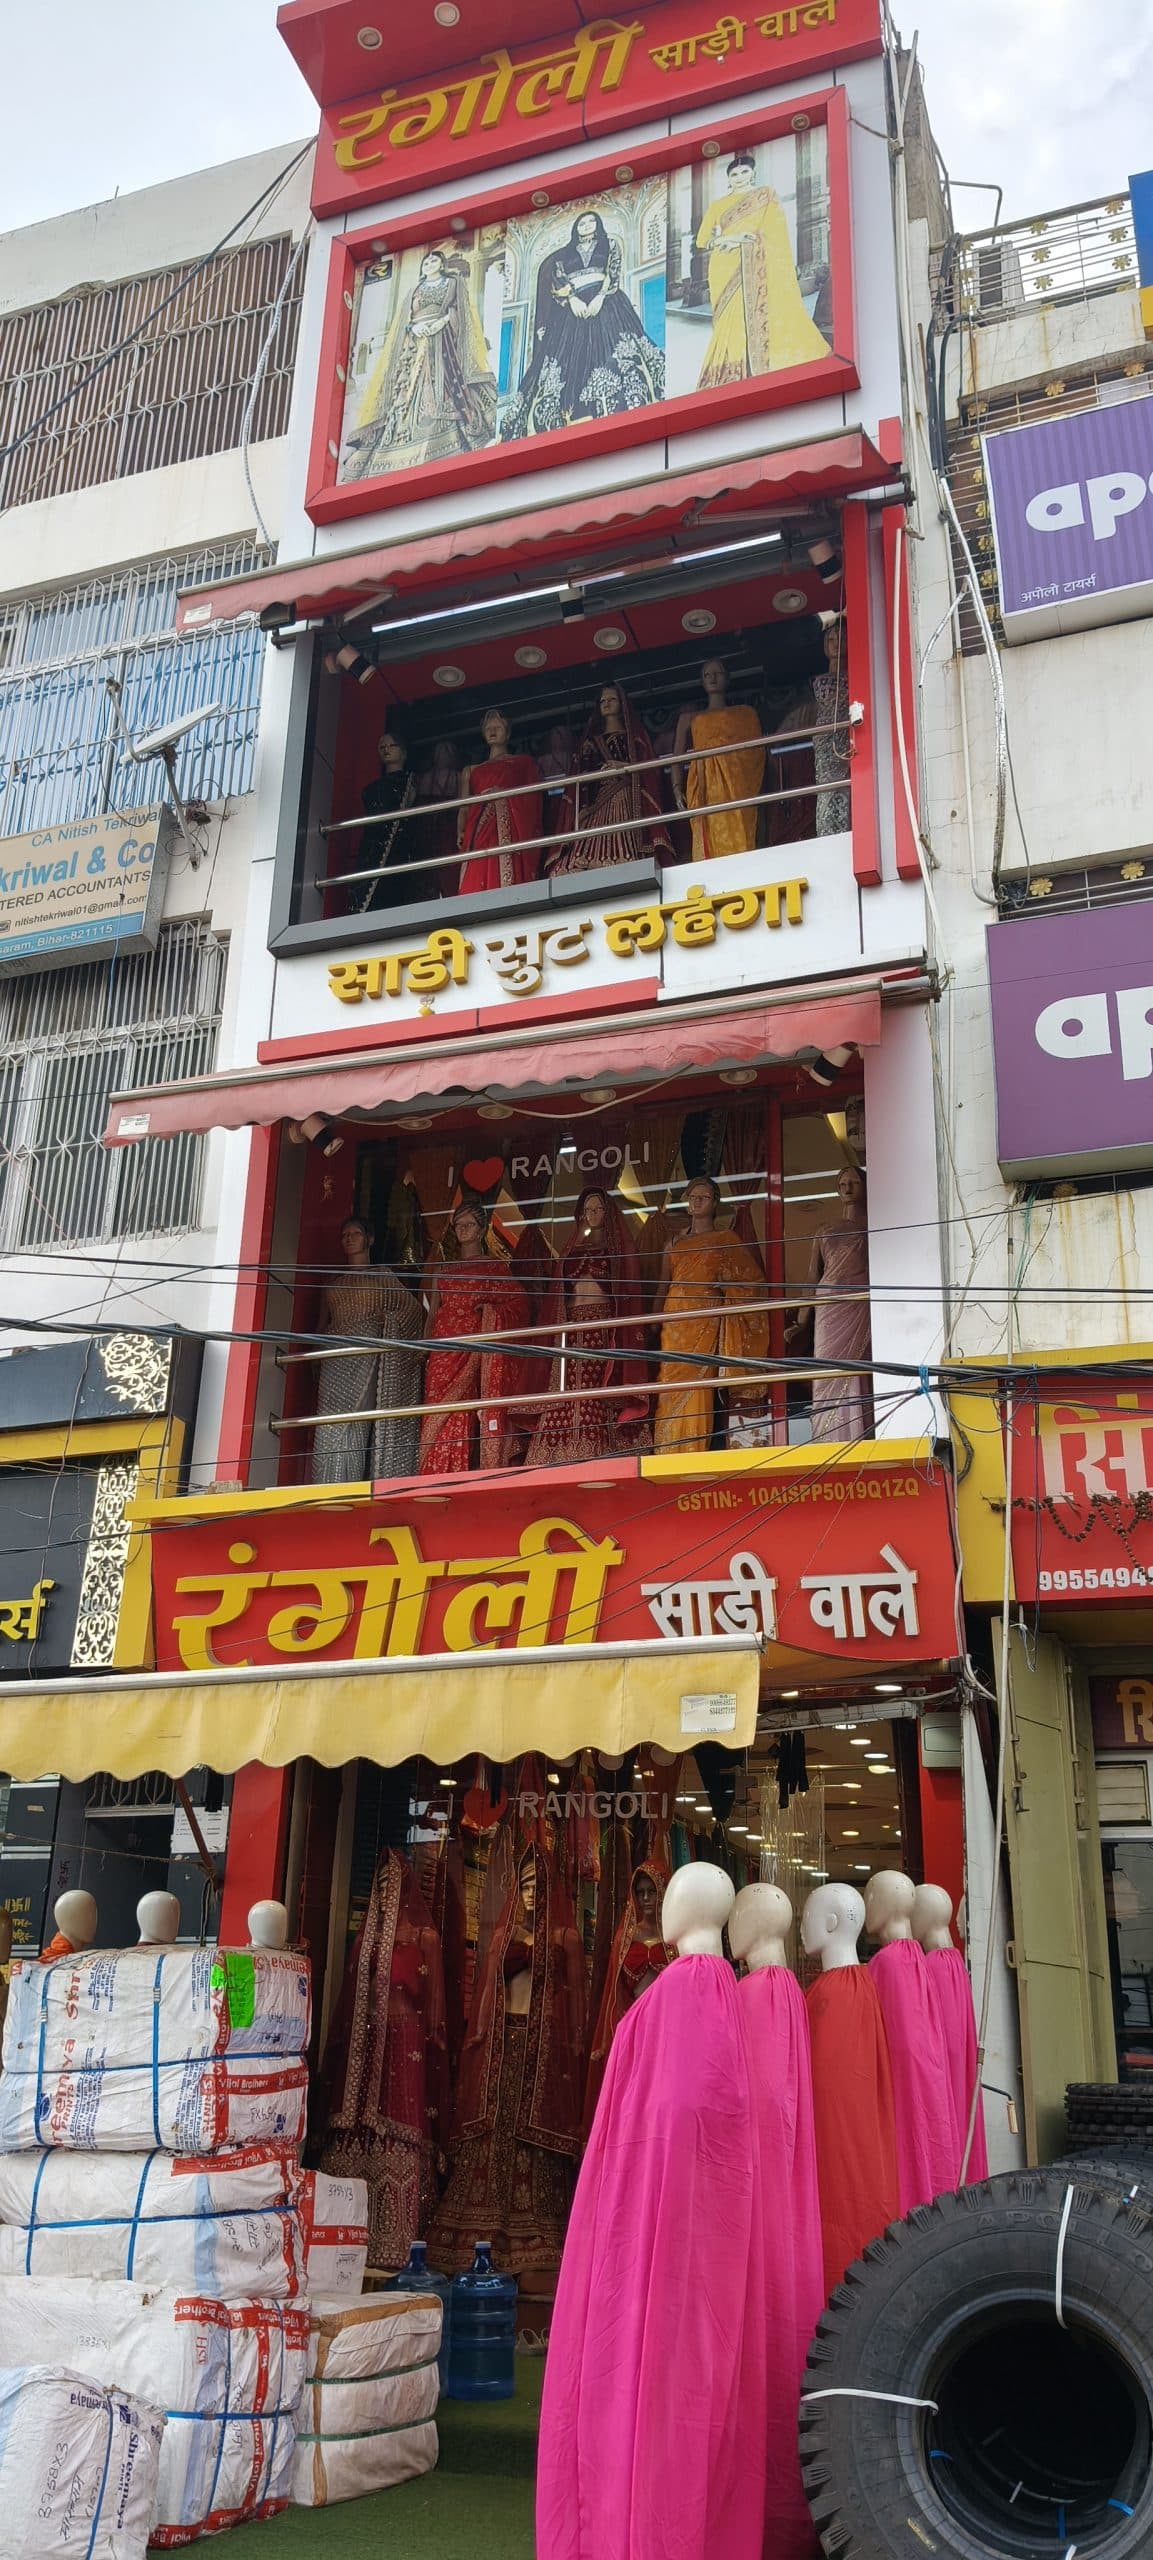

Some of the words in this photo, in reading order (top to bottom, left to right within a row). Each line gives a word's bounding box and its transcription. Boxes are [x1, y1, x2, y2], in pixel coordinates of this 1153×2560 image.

[332, 18, 645, 171] रंगोली
[754, 0, 837, 39] वाल
[1026, 472, 1153, 541] ap
[1021, 583, 1059, 602] अपोलो
[1063, 573, 1097, 593] टायर्स
[32, 834, 52, 848] CA
[58, 823, 98, 841] Nitish
[104, 809, 162, 831] Tekriwal
[87, 845, 107, 875] &
[47, 870, 150, 901] ACCOUNTANTS
[485, 917, 593, 996] सुट
[603, 876, 809, 958] लहंगा
[511, 1141, 649, 1179] RANGOLI
[171, 1516, 627, 1671] रंगोली
[801, 1542, 919, 1638] वाले
[518, 1789, 668, 1819] RANGOLI
[117, 2431, 139, 2529] Shreemaya
